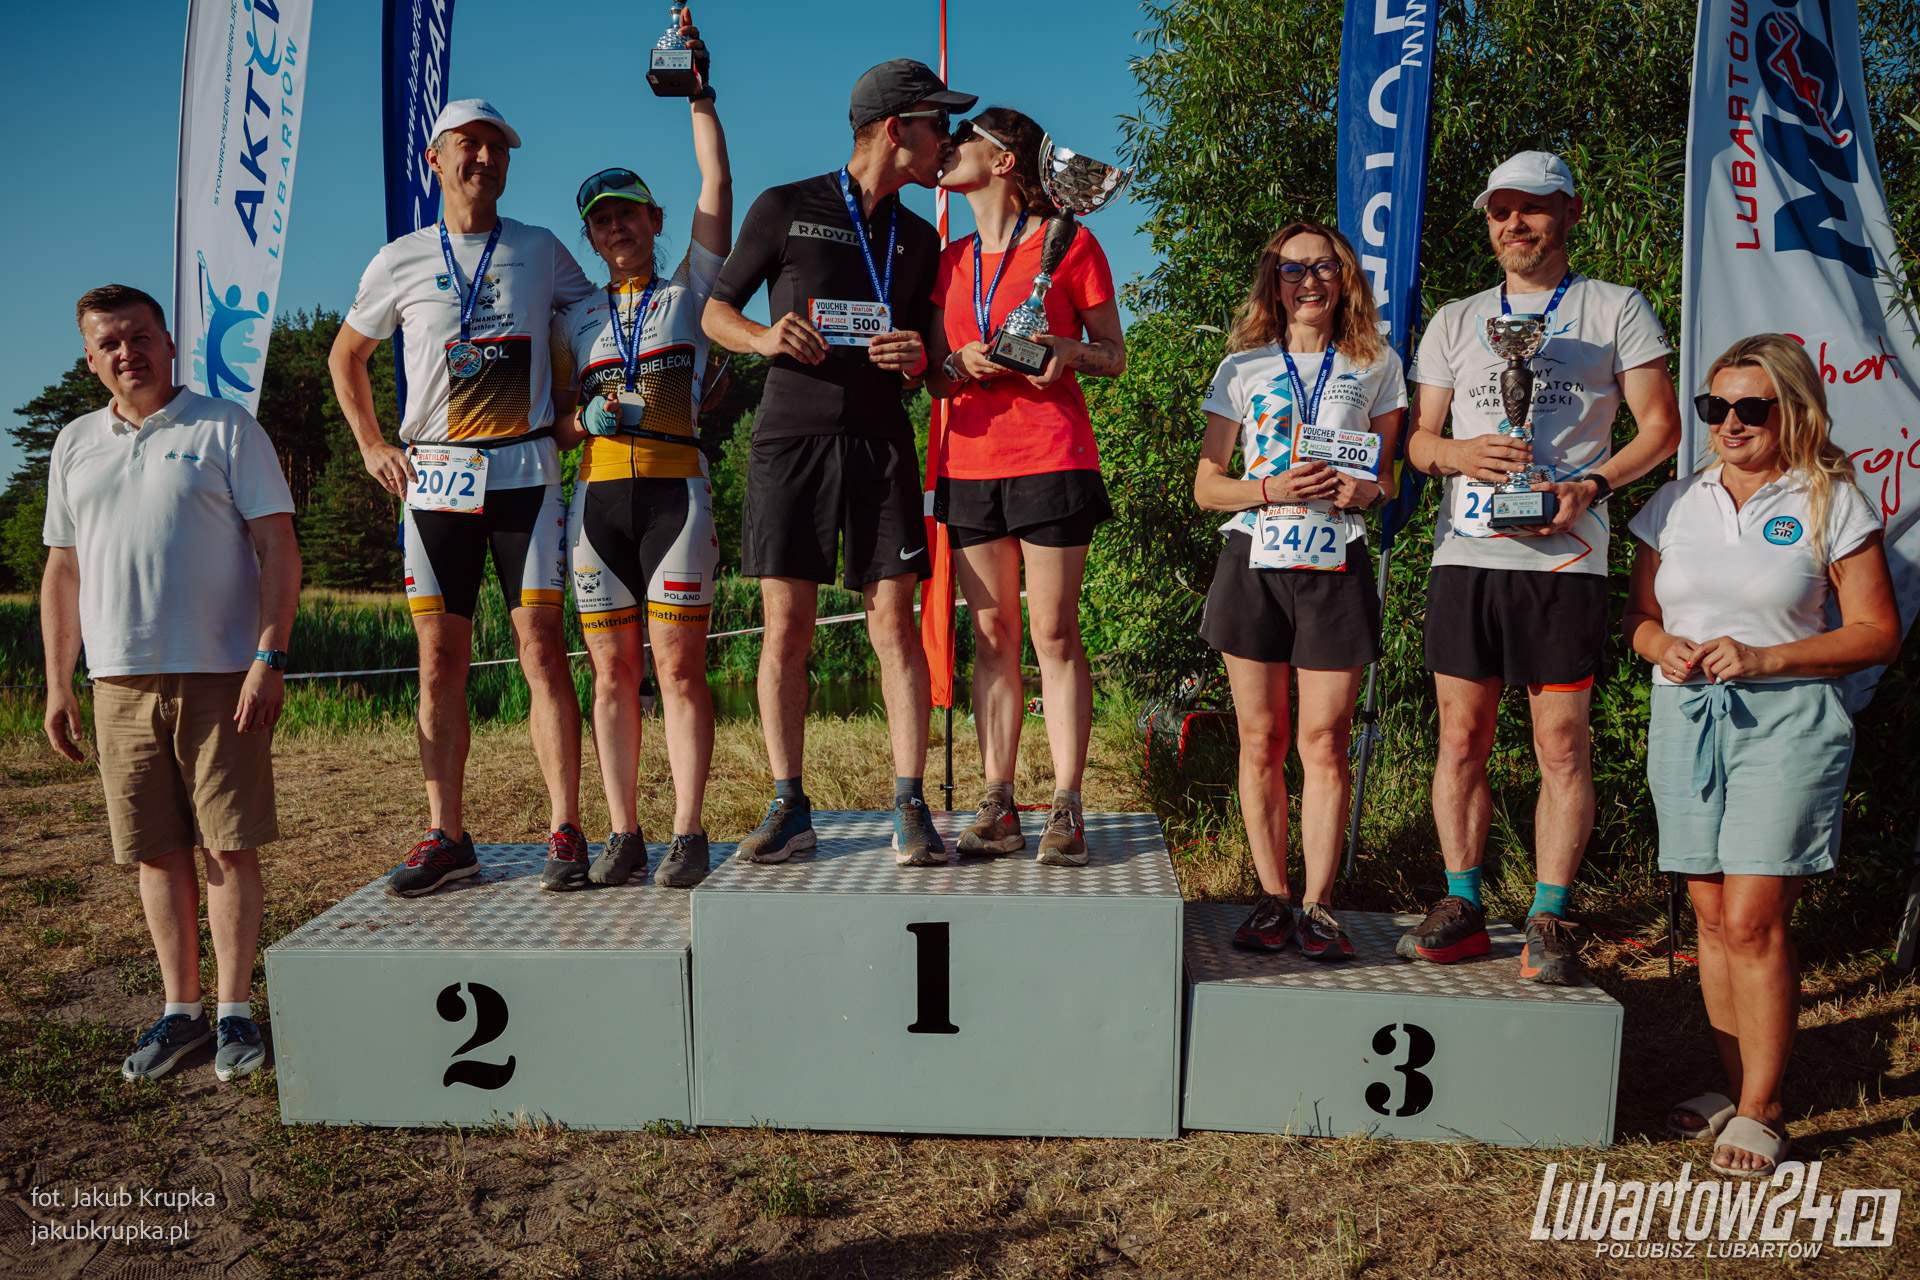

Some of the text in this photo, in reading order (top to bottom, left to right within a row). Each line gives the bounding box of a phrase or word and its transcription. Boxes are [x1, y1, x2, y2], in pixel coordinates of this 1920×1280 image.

[268, 36, 298, 259] LUBARTÓW
[815, 301, 848, 311] VOUCHER
[470, 312, 514, 324] YMANOWSKI
[816, 315, 823, 329] 1
[853, 318, 880, 331] 500
[483, 344, 510, 360] OL
[1489, 367, 1553, 381] ZWY
[1468, 380, 1585, 398] ULTRRATON
[1302, 426, 1336, 438] VOUCHER
[1299, 440, 1309, 454] 3
[1337, 446, 1368, 462] 200
[415, 453, 450, 462] TRIATHLON
[416, 469, 475, 497] 20/2
[1264, 506, 1309, 516] TRIATHLON
[1263, 525, 1337, 553] 24/2
[663, 592, 701, 601] POLAND
[906, 921, 960, 1034] 1
[436, 981, 516, 1090] 2
[1365, 1023, 1436, 1117] 3
